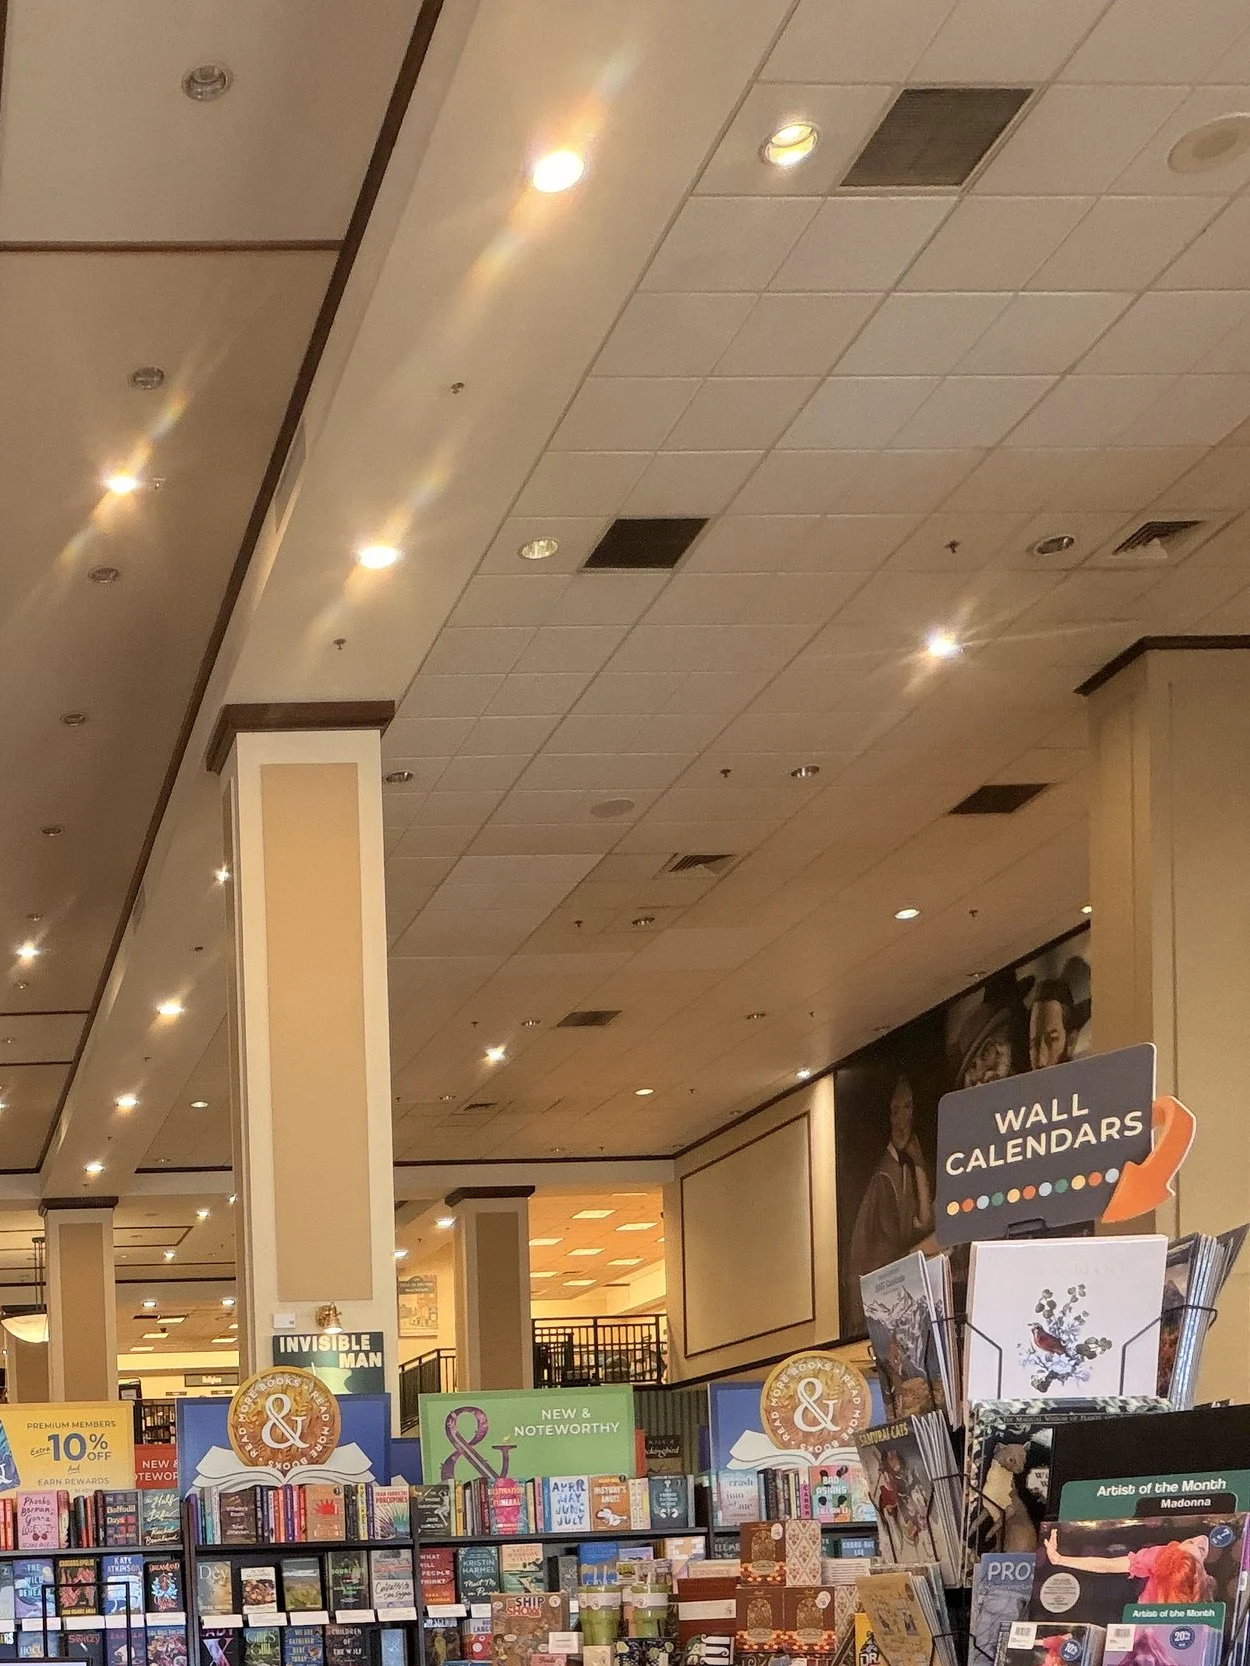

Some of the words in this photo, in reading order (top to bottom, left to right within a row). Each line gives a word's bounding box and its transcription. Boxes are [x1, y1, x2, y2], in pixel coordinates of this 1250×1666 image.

[994, 1093, 1089, 1134] WALL
[946, 1111, 1143, 1176] CALENDARS
[280, 1334, 371, 1353] INVISIBLE
[339, 1352, 382, 1369] MAN
[789, 1360, 832, 1375] BOOKS
[257, 1376, 301, 1392] BOOKS
[770, 1375, 789, 1405] MORE
[842, 1375, 860, 1405] READ
[238, 1389, 259, 1423] MORE
[310, 1390, 330, 1422] READ
[541, 1408, 577, 1420] NEW
[582, 1407, 591, 1419] &
[27, 1421, 70, 1430] PREMIUM
[72, 1420, 116, 1429] MEMBERS
[514, 1421, 620, 1437] NOTEWORTHY
[770, 1411, 790, 1442] READ
[841, 1410, 861, 1442] MORE
[890, 1423, 909, 1441] CATS
[239, 1428, 259, 1458] READ
[311, 1426, 330, 1458] MORE
[800, 1440, 840, 1453] BOOKS
[30, 1446, 50, 1456] Extra
[87, 1452, 112, 1462] OFF
[142, 1460, 172, 1469] NEW
[267, 1456, 308, 1471] BOOKS
[65, 1477, 109, 1486] REWARDS
[552, 1479, 586, 1493] APRIL
[729, 1476, 753, 1487] crash
[822, 1476, 840, 1486] BAD
[1097, 1484, 1135, 1497] Artist
[1139, 1482, 1153, 1496] of
[1156, 1481, 1178, 1494] the
[1182, 1478, 1226, 1492] Month
[816, 1486, 847, 1495] ASIANS
[557, 1493, 582, 1504] MAY
[1161, 1497, 1212, 1509] Madonna
[107, 1505, 136, 1514] Daffodil
[555, 1504, 585, 1515] JUNE
[557, 1515, 585, 1526] JULY
[114, 1556, 132, 1564] KATE
[463, 1559, 495, 1568] KRISTIN
[108, 1565, 141, 1573] ATKINSON
[462, 1566, 496, 1574] HARMEL
[516, 1597, 545, 1607] SHIP
[1132, 1609, 1158, 1618] Artist
[1160, 1609, 1168, 1617] of
[1169, 1609, 1185, 1617] the
[1187, 1609, 1215, 1617] Month
